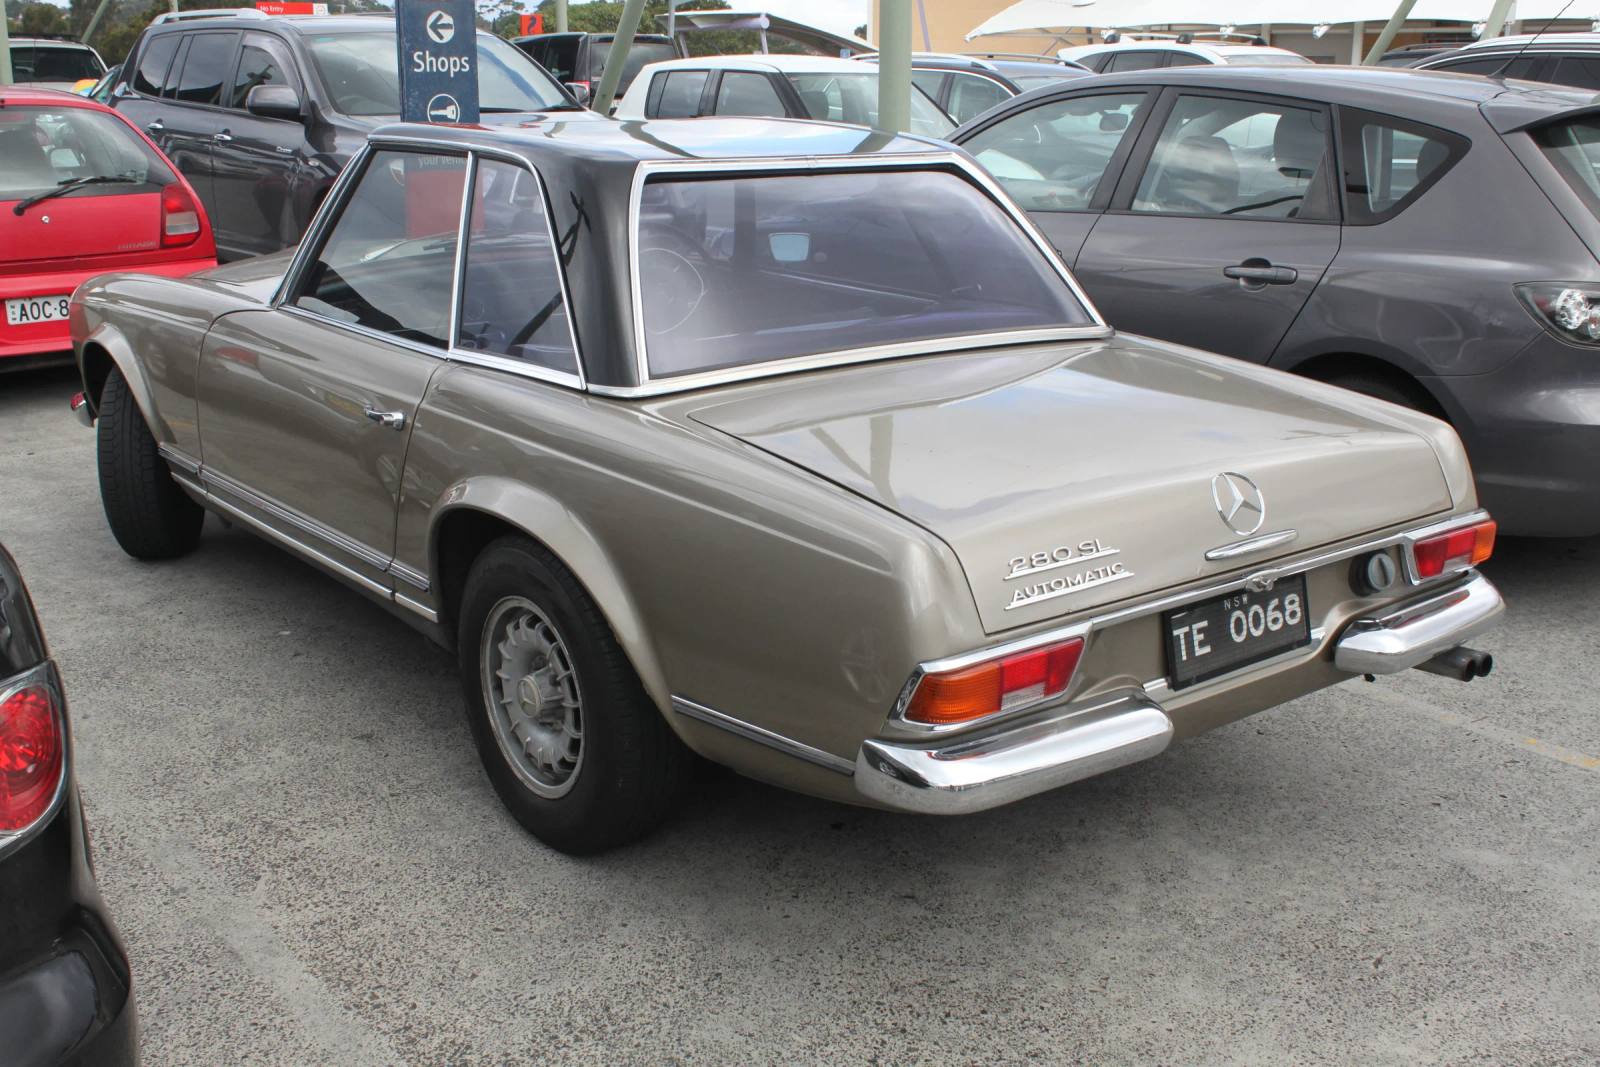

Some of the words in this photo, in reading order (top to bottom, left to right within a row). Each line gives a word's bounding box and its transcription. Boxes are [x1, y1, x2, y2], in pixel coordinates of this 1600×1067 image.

[269, 5, 284, 14] Entry
[413, 50, 470, 78] Shops
[1008, 546, 1072, 574] 280
[1077, 538, 1112, 556] SL
[1011, 562, 1125, 604] AUTOMATIC
[1223, 593, 1248, 610] NSW
[1172, 620, 1212, 661] TE
[1229, 593, 1301, 643] 0068
